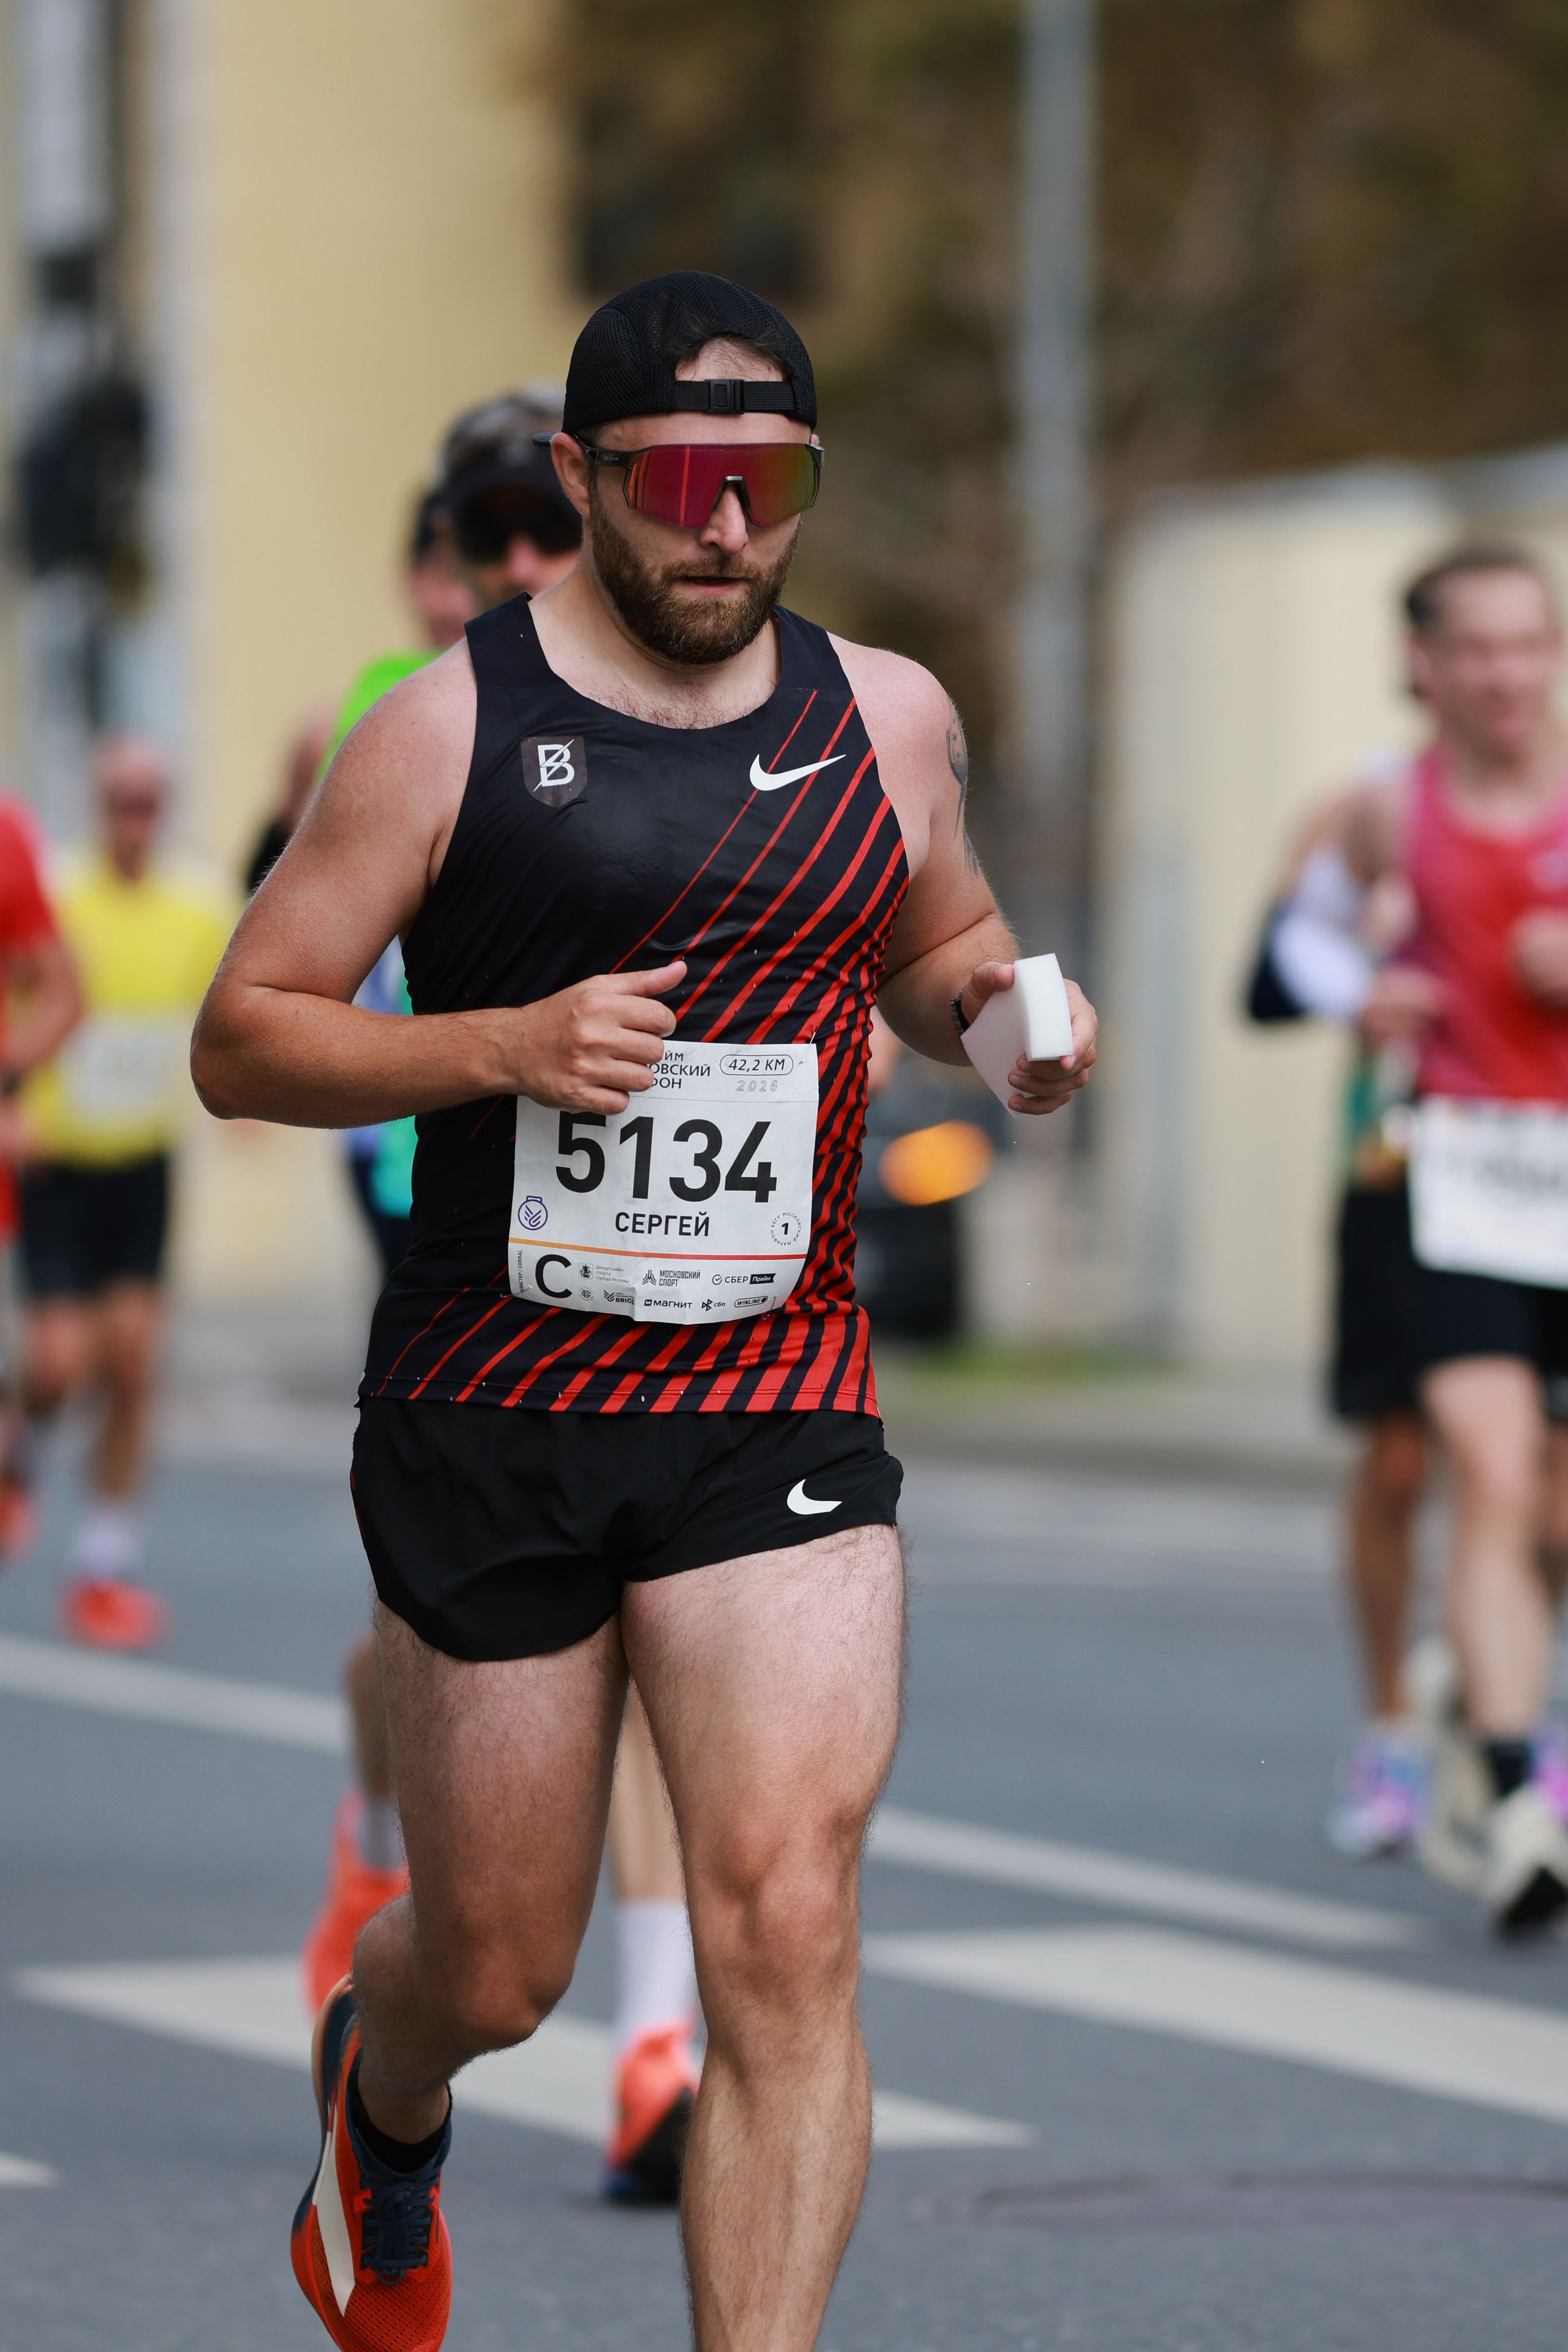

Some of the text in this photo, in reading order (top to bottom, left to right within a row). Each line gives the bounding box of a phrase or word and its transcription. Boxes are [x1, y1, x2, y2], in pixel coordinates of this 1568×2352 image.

[648, 1063, 710, 1077] ОВСКИЙ
[728, 1058, 785, 1072] 42,2 КМ
[736, 1080, 777, 1091] 2026
[556, 1111, 777, 1203] 5134
[615, 1212, 710, 1237] СЕРГЕЙ
[781, 1223, 789, 1235] 1
[535, 1254, 572, 1298] C
[659, 1270, 701, 1280] МОСКОВСКИЙ
[659, 1278, 679, 1287] СПОРТ
